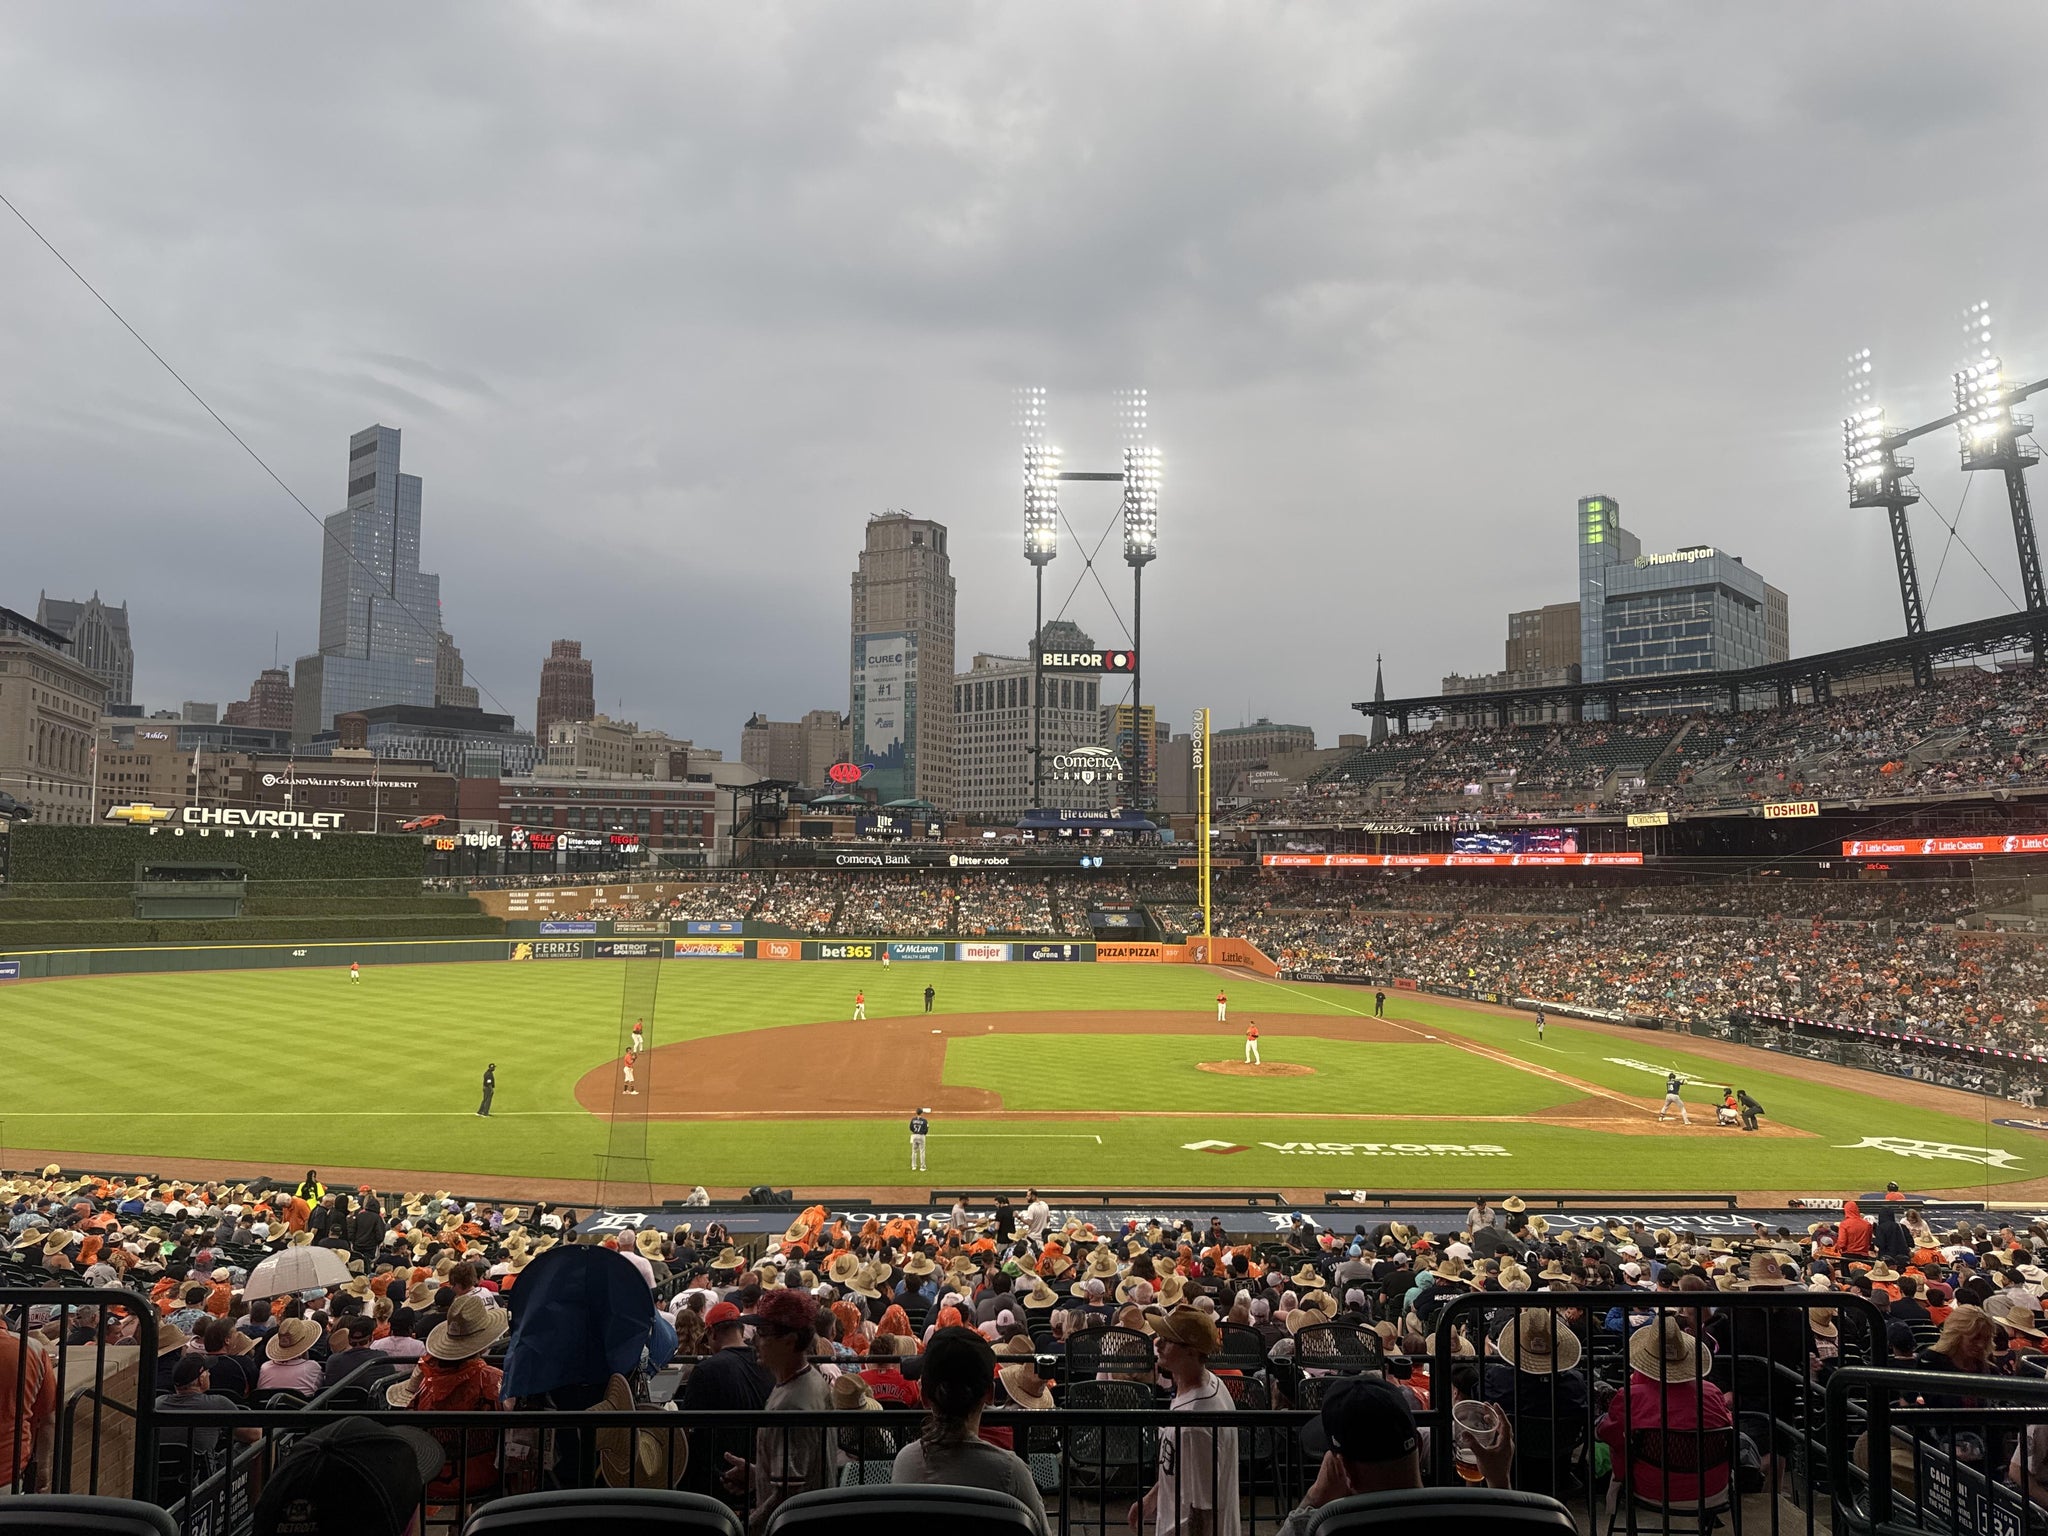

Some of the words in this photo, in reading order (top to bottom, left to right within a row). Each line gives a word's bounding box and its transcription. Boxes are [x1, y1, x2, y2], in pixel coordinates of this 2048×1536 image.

[1649, 548, 1714, 566] Huntington
[868, 655, 895, 664] CURE
[1042, 653, 1102, 667] BELFOR
[878, 684, 891, 696] #1
[143, 731, 169, 741] Ashley
[1192, 722, 1204, 770] Rocket
[832, 764, 858, 779] AAA
[1053, 771, 1124, 781] LANDING
[275, 776, 308, 785] GRAND
[308, 777, 339, 787] VALLEY
[339, 779, 366, 788] STATE
[366, 779, 419, 789] UNIVERSITY
[1078, 811, 1109, 819] LOUNGE
[1766, 803, 1817, 817] TOSHIBA
[182, 807, 345, 828] CHEVROLET
[877, 815, 893, 828] Lite
[1361, 822, 1394, 831] Motor
[1423, 823, 1450, 832] TIGER
[1458, 822, 1480, 831] CLUB
[150, 827, 321, 840] FOUNTAIN
[529, 834, 556, 842] BELLE
[436, 838, 455, 851] 0:05
[620, 844, 640, 853] LAW
[1865, 844, 1881, 852] Little
[1881, 843, 1905, 852] Caesars
[1938, 841, 1956, 851] Little
[1957, 840, 1984, 850] Caesars
[2022, 838, 2042, 849] Little
[885, 855, 911, 864] Bank
[595, 888, 604, 897] 10
[626, 886, 634, 894] 11
[655, 885, 664, 893] 42
[535, 942, 580, 953] FERRIS
[680, 943, 719, 955] Surfside
[770, 943, 789, 957] hap
[821, 944, 872, 958] bet365
[905, 945, 938, 953] McLaren
[967, 945, 1001, 959] meijer
[1098, 948, 1127, 958] PIZZA!
[1129, 948, 1159, 958] PIZZA!
[1032, 950, 1058, 960] Corona
[1222, 952, 1243, 962] Little
[1477, 991, 1497, 1002] bet365
[1258, 1141, 1507, 1152] VICTORS
[1930, 1466, 1968, 1498] CAUTN!
[276, 1521, 318, 1533] DETROIT
